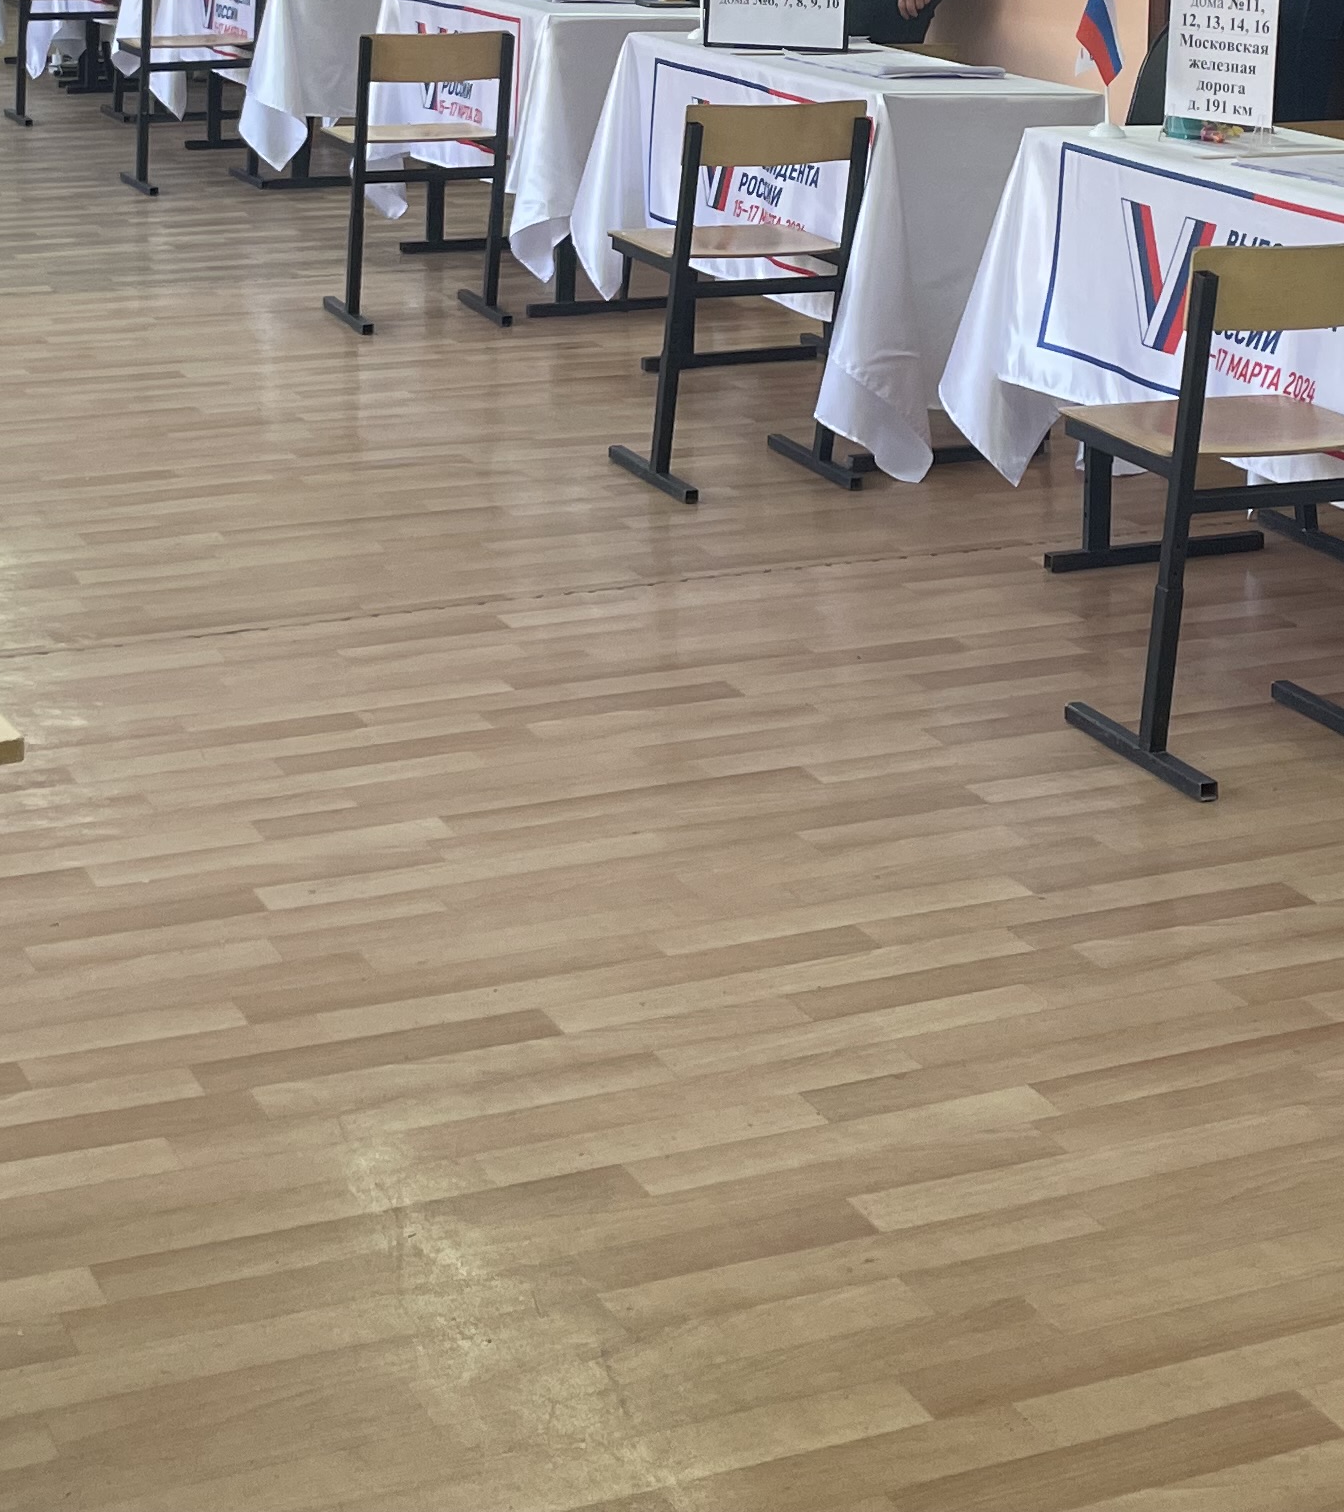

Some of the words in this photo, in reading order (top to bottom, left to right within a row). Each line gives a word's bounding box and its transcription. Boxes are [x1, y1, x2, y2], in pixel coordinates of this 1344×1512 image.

[1182, 13, 1200, 29] 12,
[1206, 15, 1225, 31] 13,
[1230, 17, 1249, 33] 14,
[1254, 20, 1270, 34] 16
[1179, 33, 1269, 56] Московская
[1188, 58, 1256, 75] железная
[1196, 79, 1246, 95] дорога
[1187, 99, 1200, 111] д.
[1205, 98, 1227, 114] 191
[1232, 104, 1253, 117] км
[1225, 356, 1282, 392] МАРТА
[1283, 371, 1316, 404] 2024
